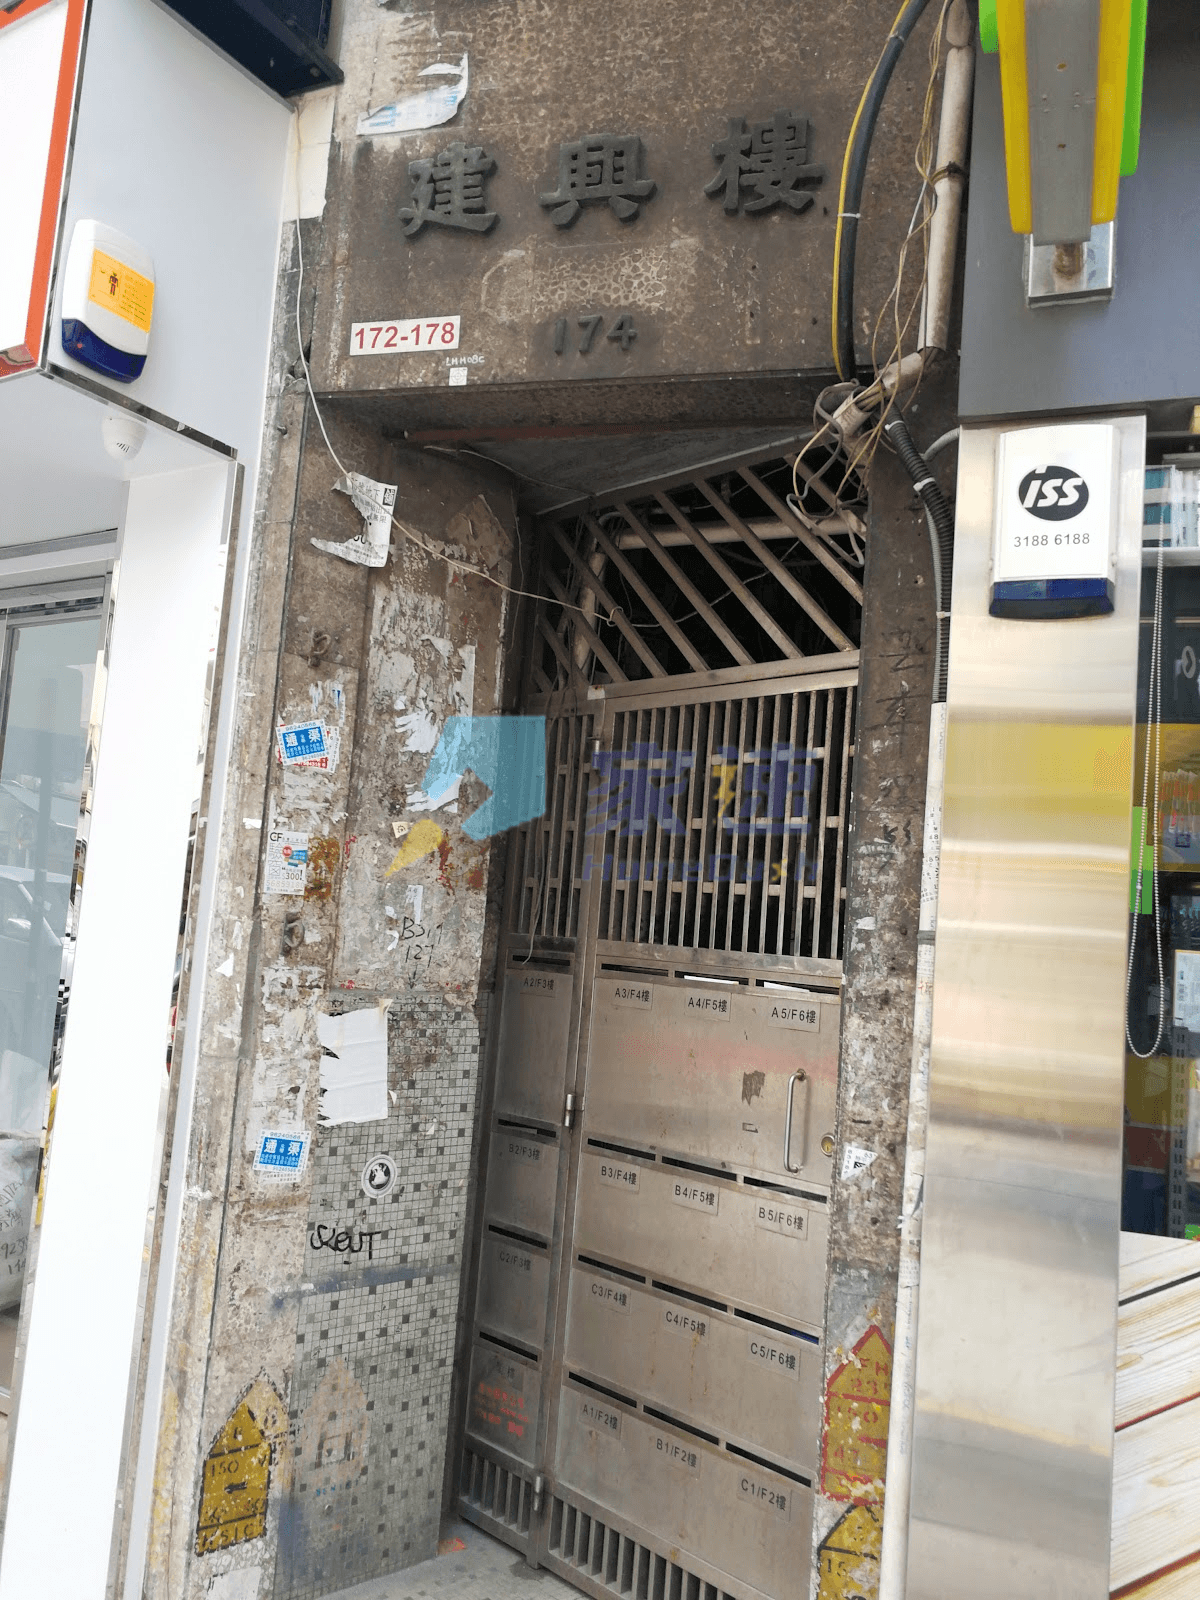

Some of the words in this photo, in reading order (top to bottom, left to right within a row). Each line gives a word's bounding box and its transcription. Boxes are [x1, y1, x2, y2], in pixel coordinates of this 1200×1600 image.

[401, 110, 828, 238] 建興樓
[354, 322, 455, 350] 172-178
[553, 313, 638, 354] 174
[1014, 535, 1048, 547] 3188
[1054, 533, 1090, 545] 6188
[269, 832, 283, 842] CF
[614, 987, 650, 1003] A3/F4樓
[687, 997, 728, 1013] A4/F5樓
[771, 1006, 817, 1025] A5/F6樓
[600, 1165, 637, 1186] B3/F4樓
[674, 1185, 715, 1207] B4/F5樓
[758, 1206, 804, 1231] B5/F6樓
[591, 1283, 628, 1307] C3/F4樓
[665, 1311, 706, 1337] C4/F5樓
[750, 1342, 796, 1371] C5/F6樓
[582, 1405, 618, 1430] A1/F2樓
[656, 1438, 697, 1469] B1/F2樓
[741, 1479, 787, 1512] C1/F2樓
